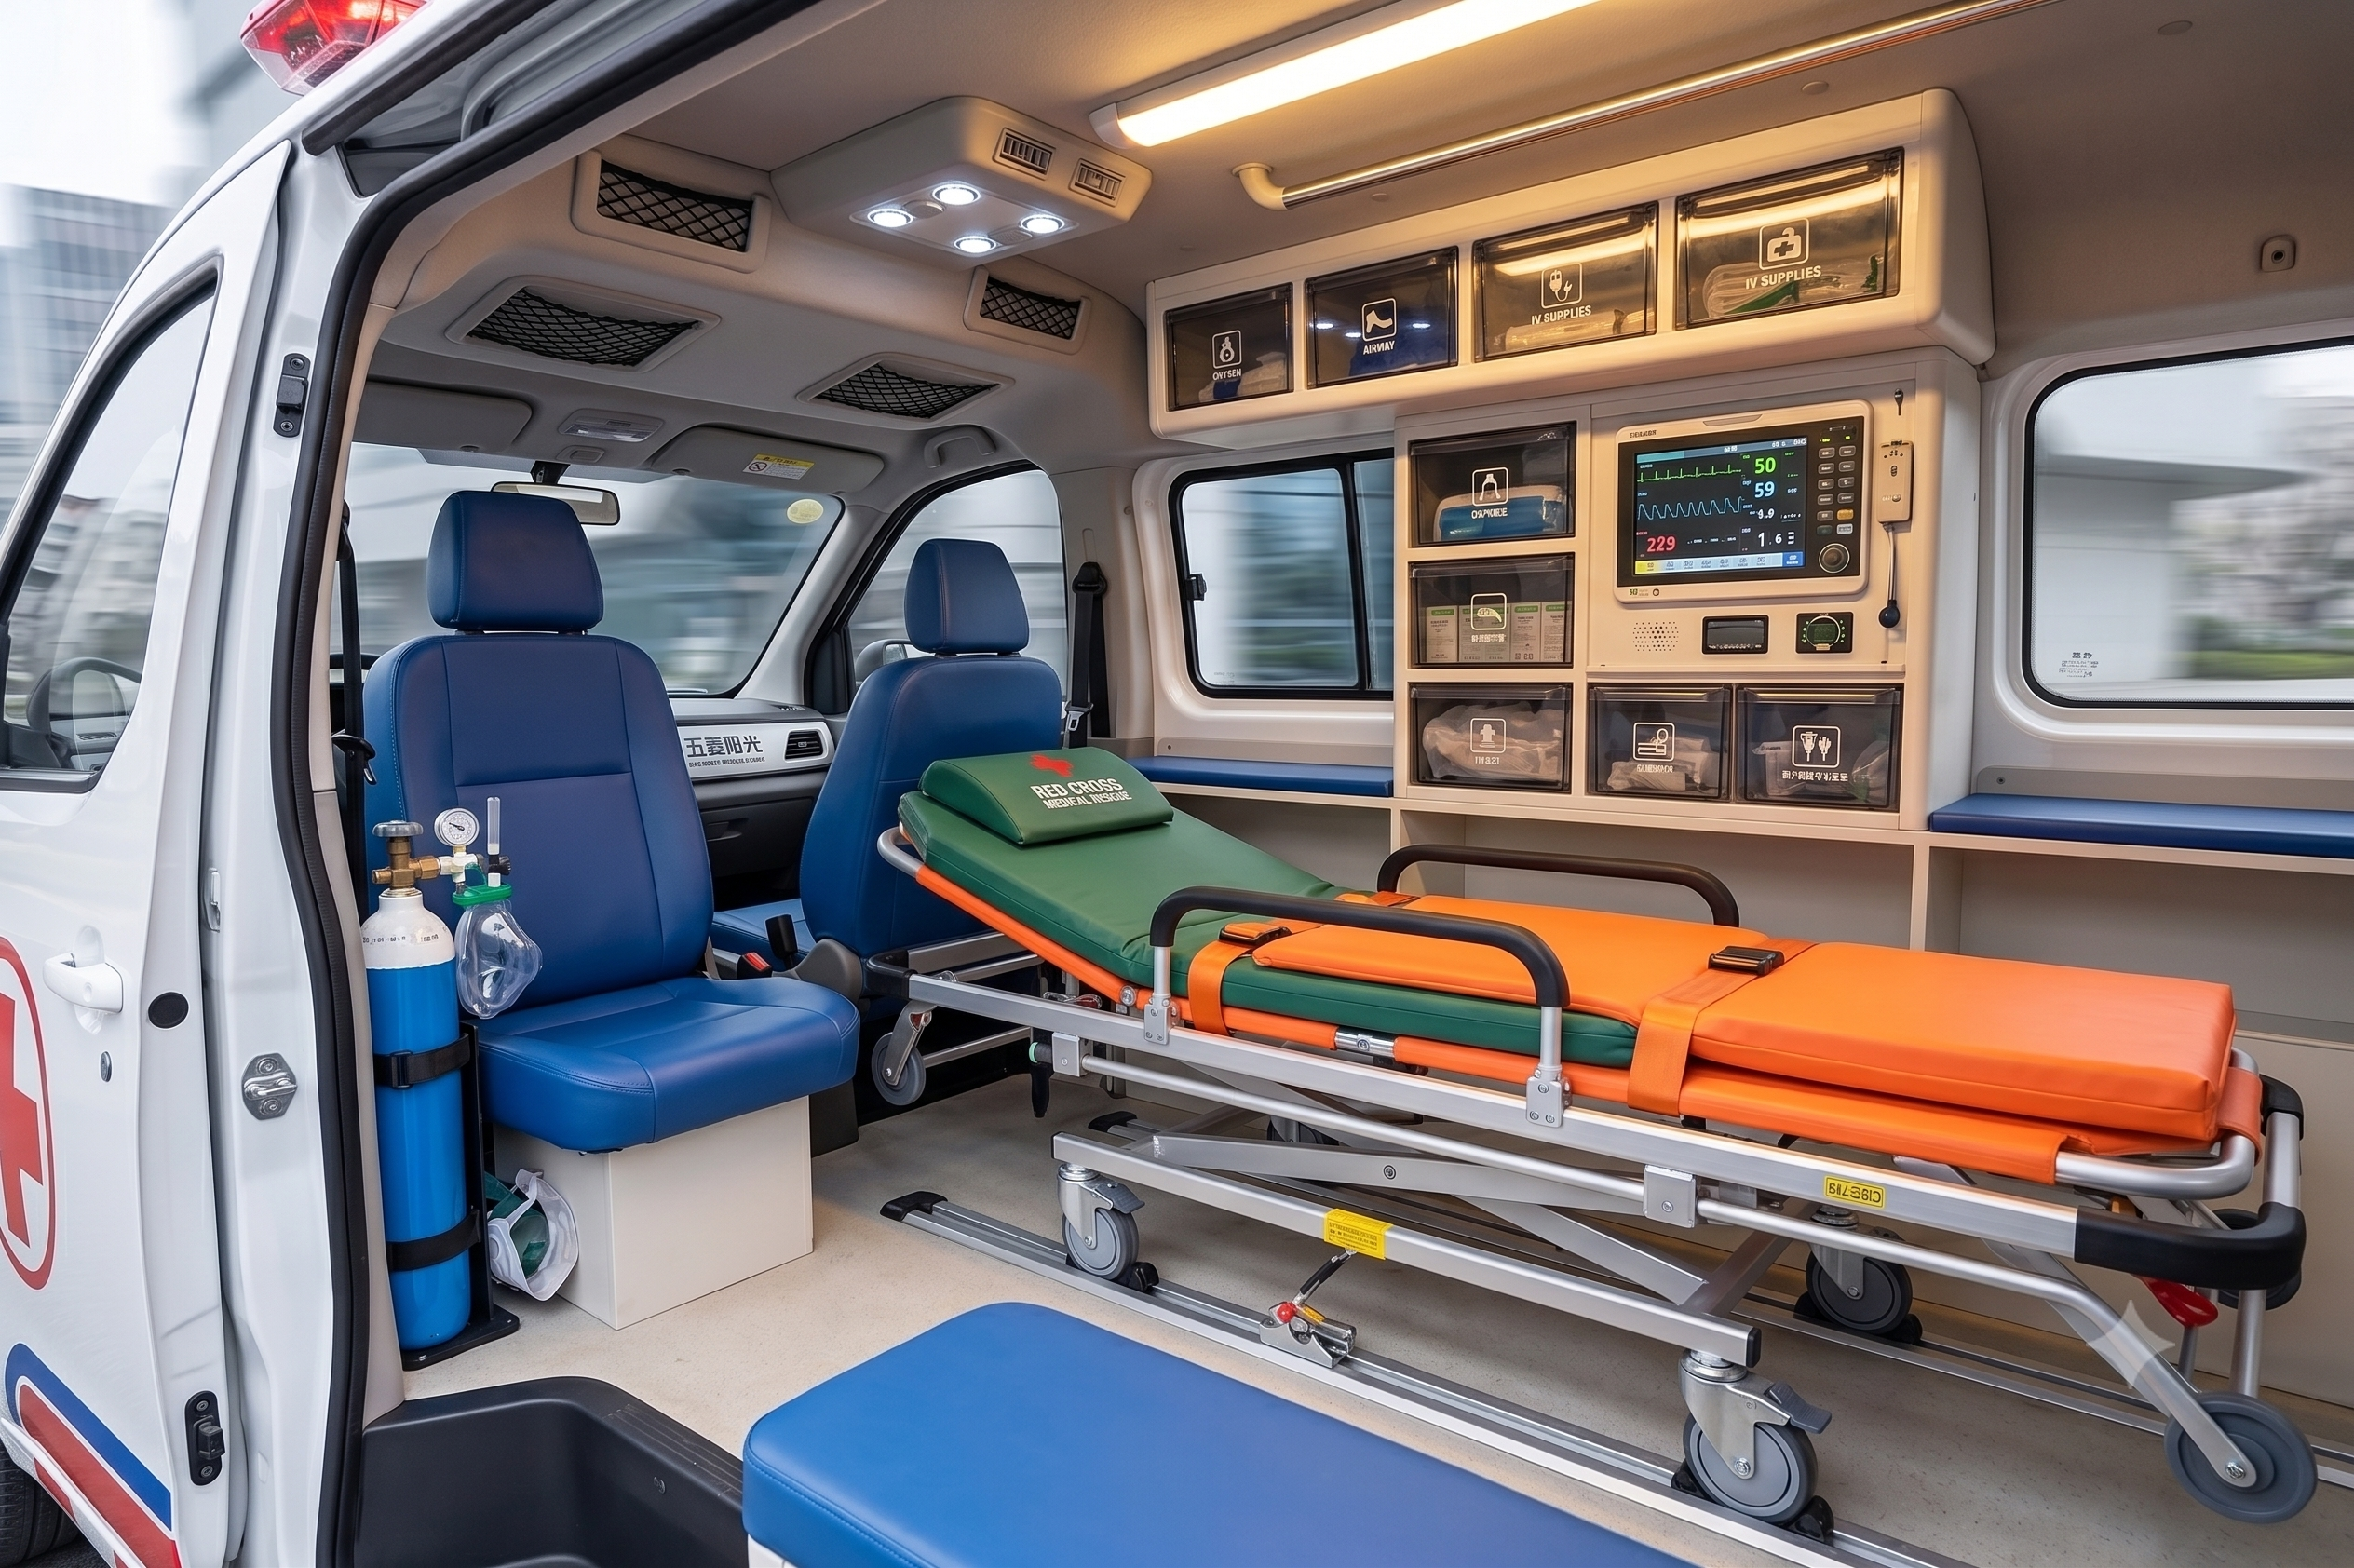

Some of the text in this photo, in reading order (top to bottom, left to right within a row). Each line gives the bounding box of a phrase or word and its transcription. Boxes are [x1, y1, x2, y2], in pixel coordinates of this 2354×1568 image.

[1745, 265, 1822, 290] IV SUPPLIES
[1531, 304, 1592, 325] IV SUPPLIES
[1754, 456, 1777, 474] 50
[1754, 480, 1775, 498] 59
[1646, 535, 1676, 552] 229
[683, 735, 764, 758] 五菱阳光
[1030, 778, 1124, 799] RED CROSS
